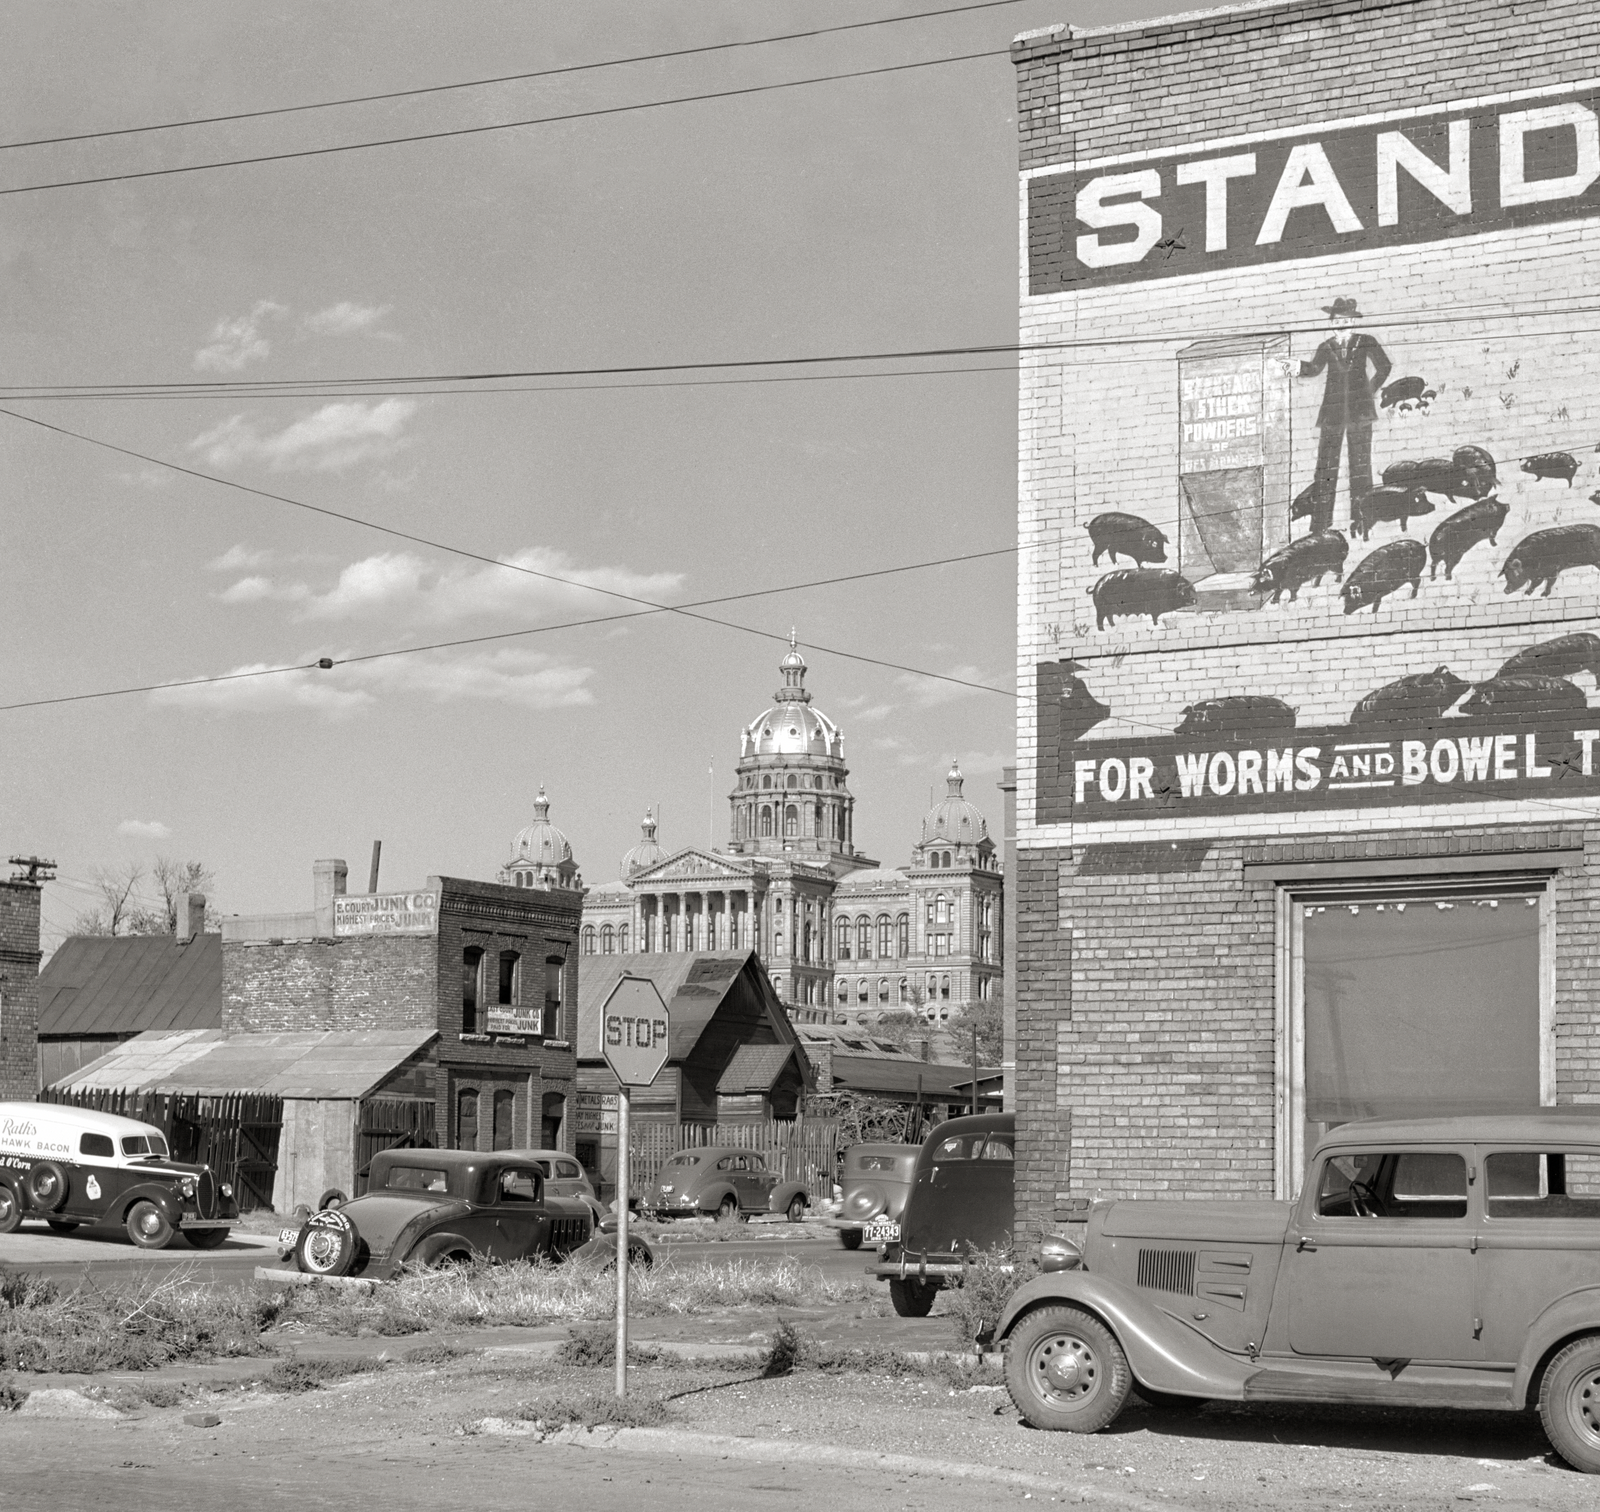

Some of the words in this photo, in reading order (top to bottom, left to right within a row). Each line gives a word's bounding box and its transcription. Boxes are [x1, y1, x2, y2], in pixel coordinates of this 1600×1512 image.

[1075, 101, 1600, 268] STAND
[1183, 416, 1257, 442] POWDERS
[1074, 757, 1155, 803] FOR
[1175, 746, 1322, 798] WORMS
[1329, 752, 1395, 779] AND
[1402, 734, 1552, 786] BOWEL
[371, 896, 409, 911] JUNK
[370, 914, 395, 924] PRICES
[395, 912, 431, 927] JUNK
[513, 1008, 531, 1018] JUNK
[517, 1020, 539, 1031] JUNK
[606, 1015, 666, 1048] STOP
[580, 1095, 600, 1105] METALS
[601, 1096, 618, 1105] RAGS
[594, 1122, 614, 1131] JUNK
[36, 1142, 70, 1153] BACON
[6, 1158, 31, 1170] O'Corn
